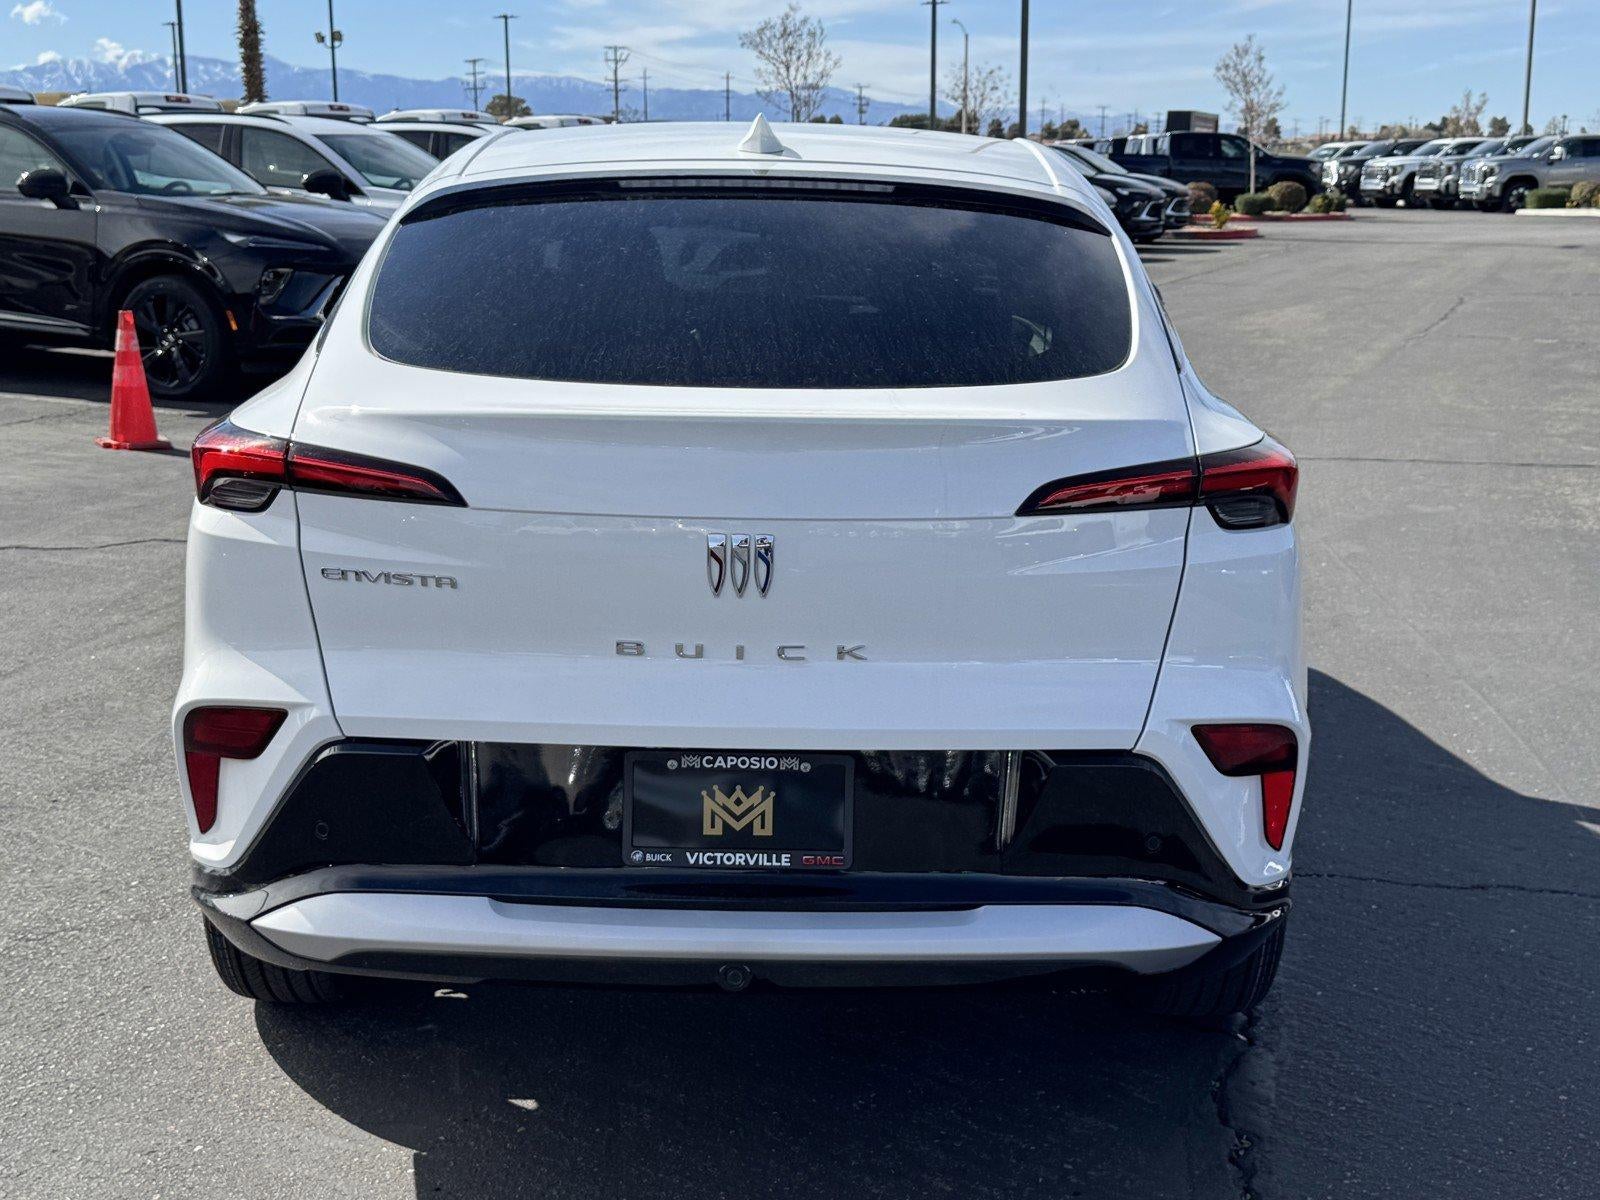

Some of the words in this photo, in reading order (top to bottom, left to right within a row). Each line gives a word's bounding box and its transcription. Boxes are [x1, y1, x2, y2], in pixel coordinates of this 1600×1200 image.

[320, 567, 457, 589] ENVISTA
[615, 640, 868, 660] BUICK
[702, 755, 778, 770] CAPOSIO
[645, 853, 672, 862] BUICK
[686, 851, 791, 867] VICTORVILLE
[802, 855, 844, 865] GMC
